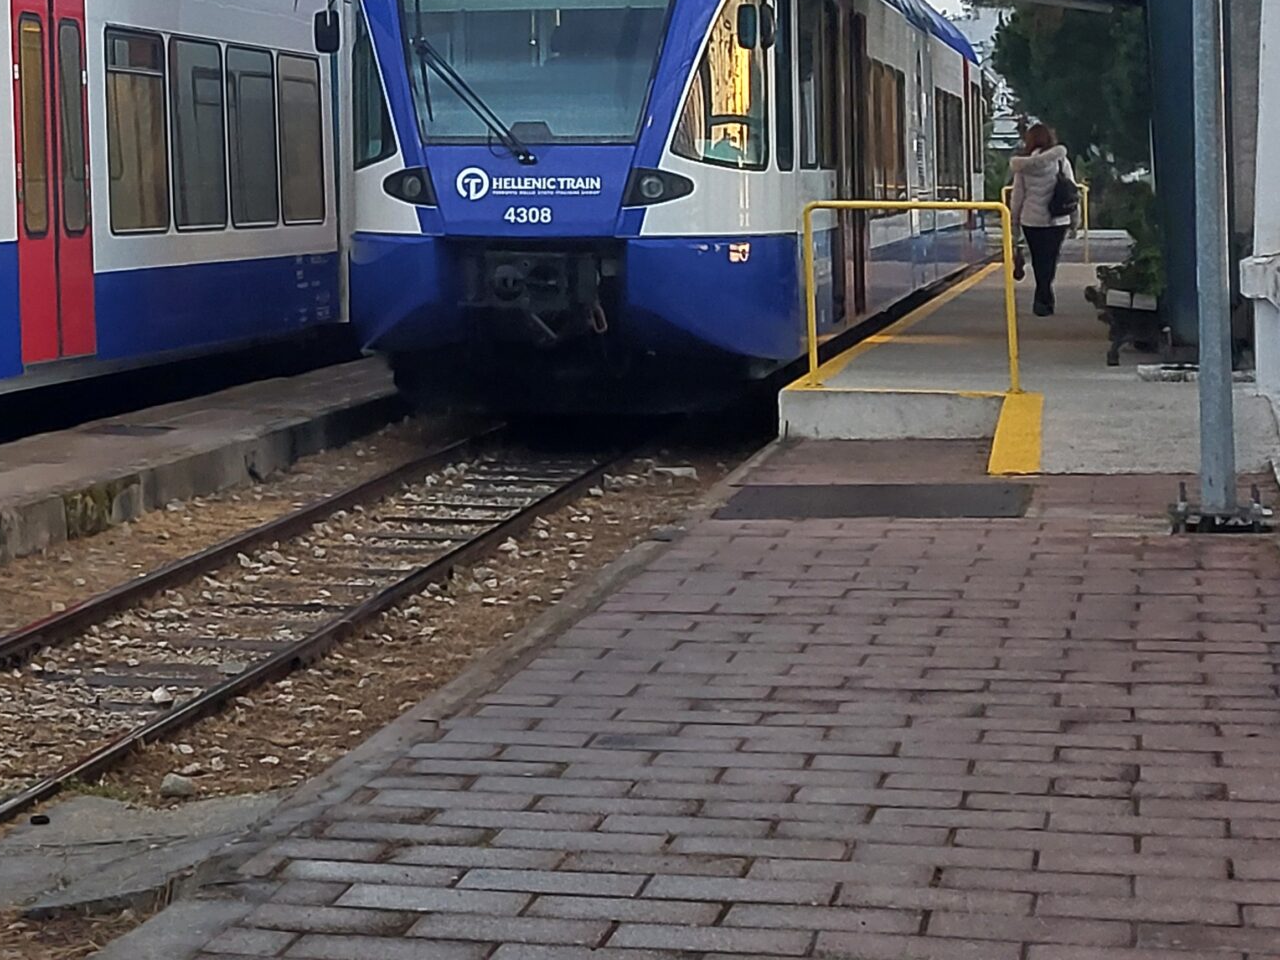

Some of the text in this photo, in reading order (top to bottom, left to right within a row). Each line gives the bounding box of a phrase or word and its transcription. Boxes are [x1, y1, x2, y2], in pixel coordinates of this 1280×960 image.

[492, 176, 601, 190] HELLENIC TRAIN
[503, 206, 552, 224] 4308
